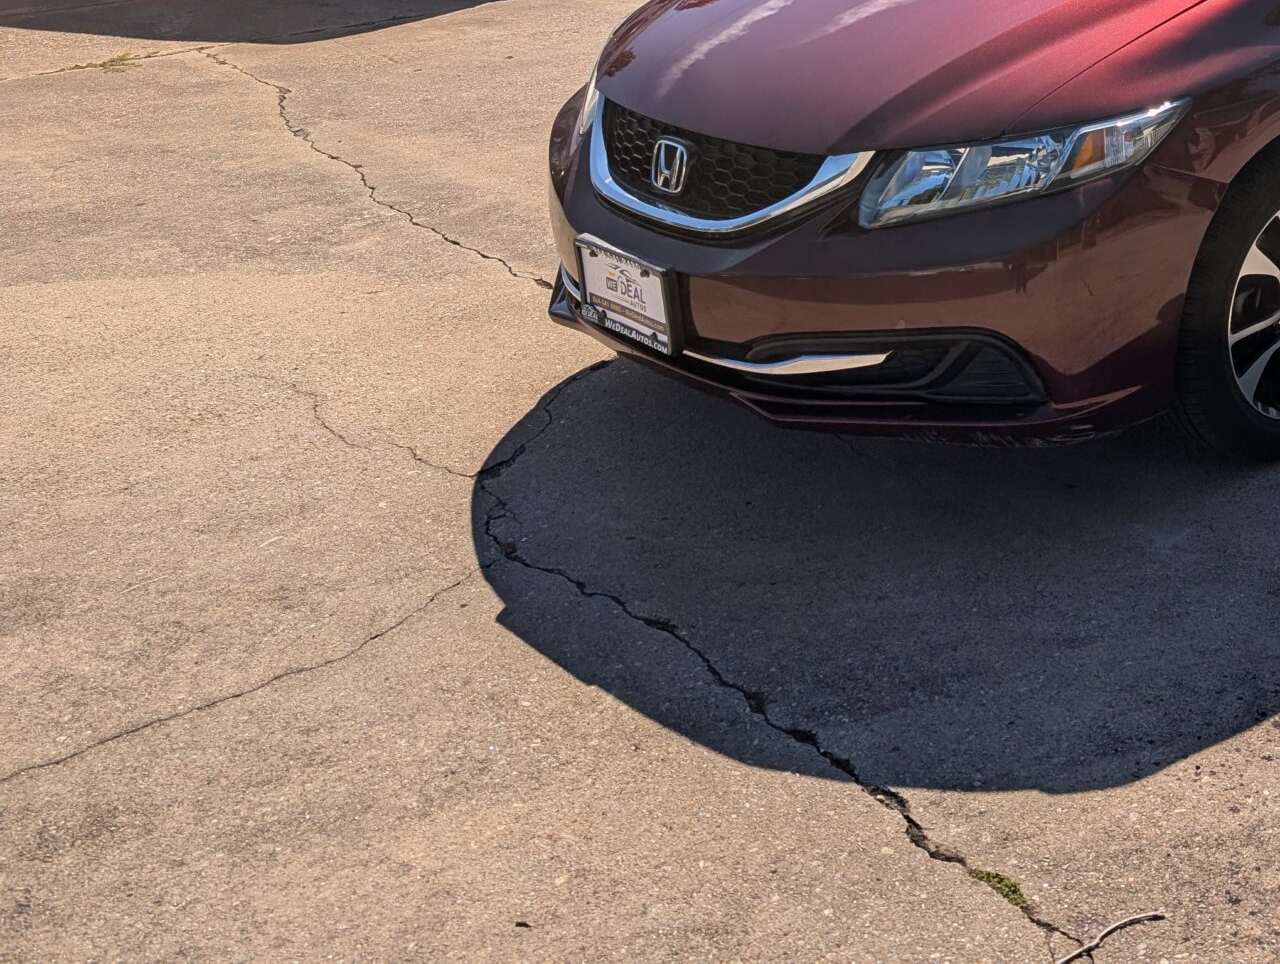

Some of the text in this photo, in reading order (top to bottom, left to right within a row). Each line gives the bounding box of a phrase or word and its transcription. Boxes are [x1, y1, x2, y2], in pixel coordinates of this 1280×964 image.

[606, 277, 646, 304] WE DEAL
[629, 298, 647, 313] AUTOS
